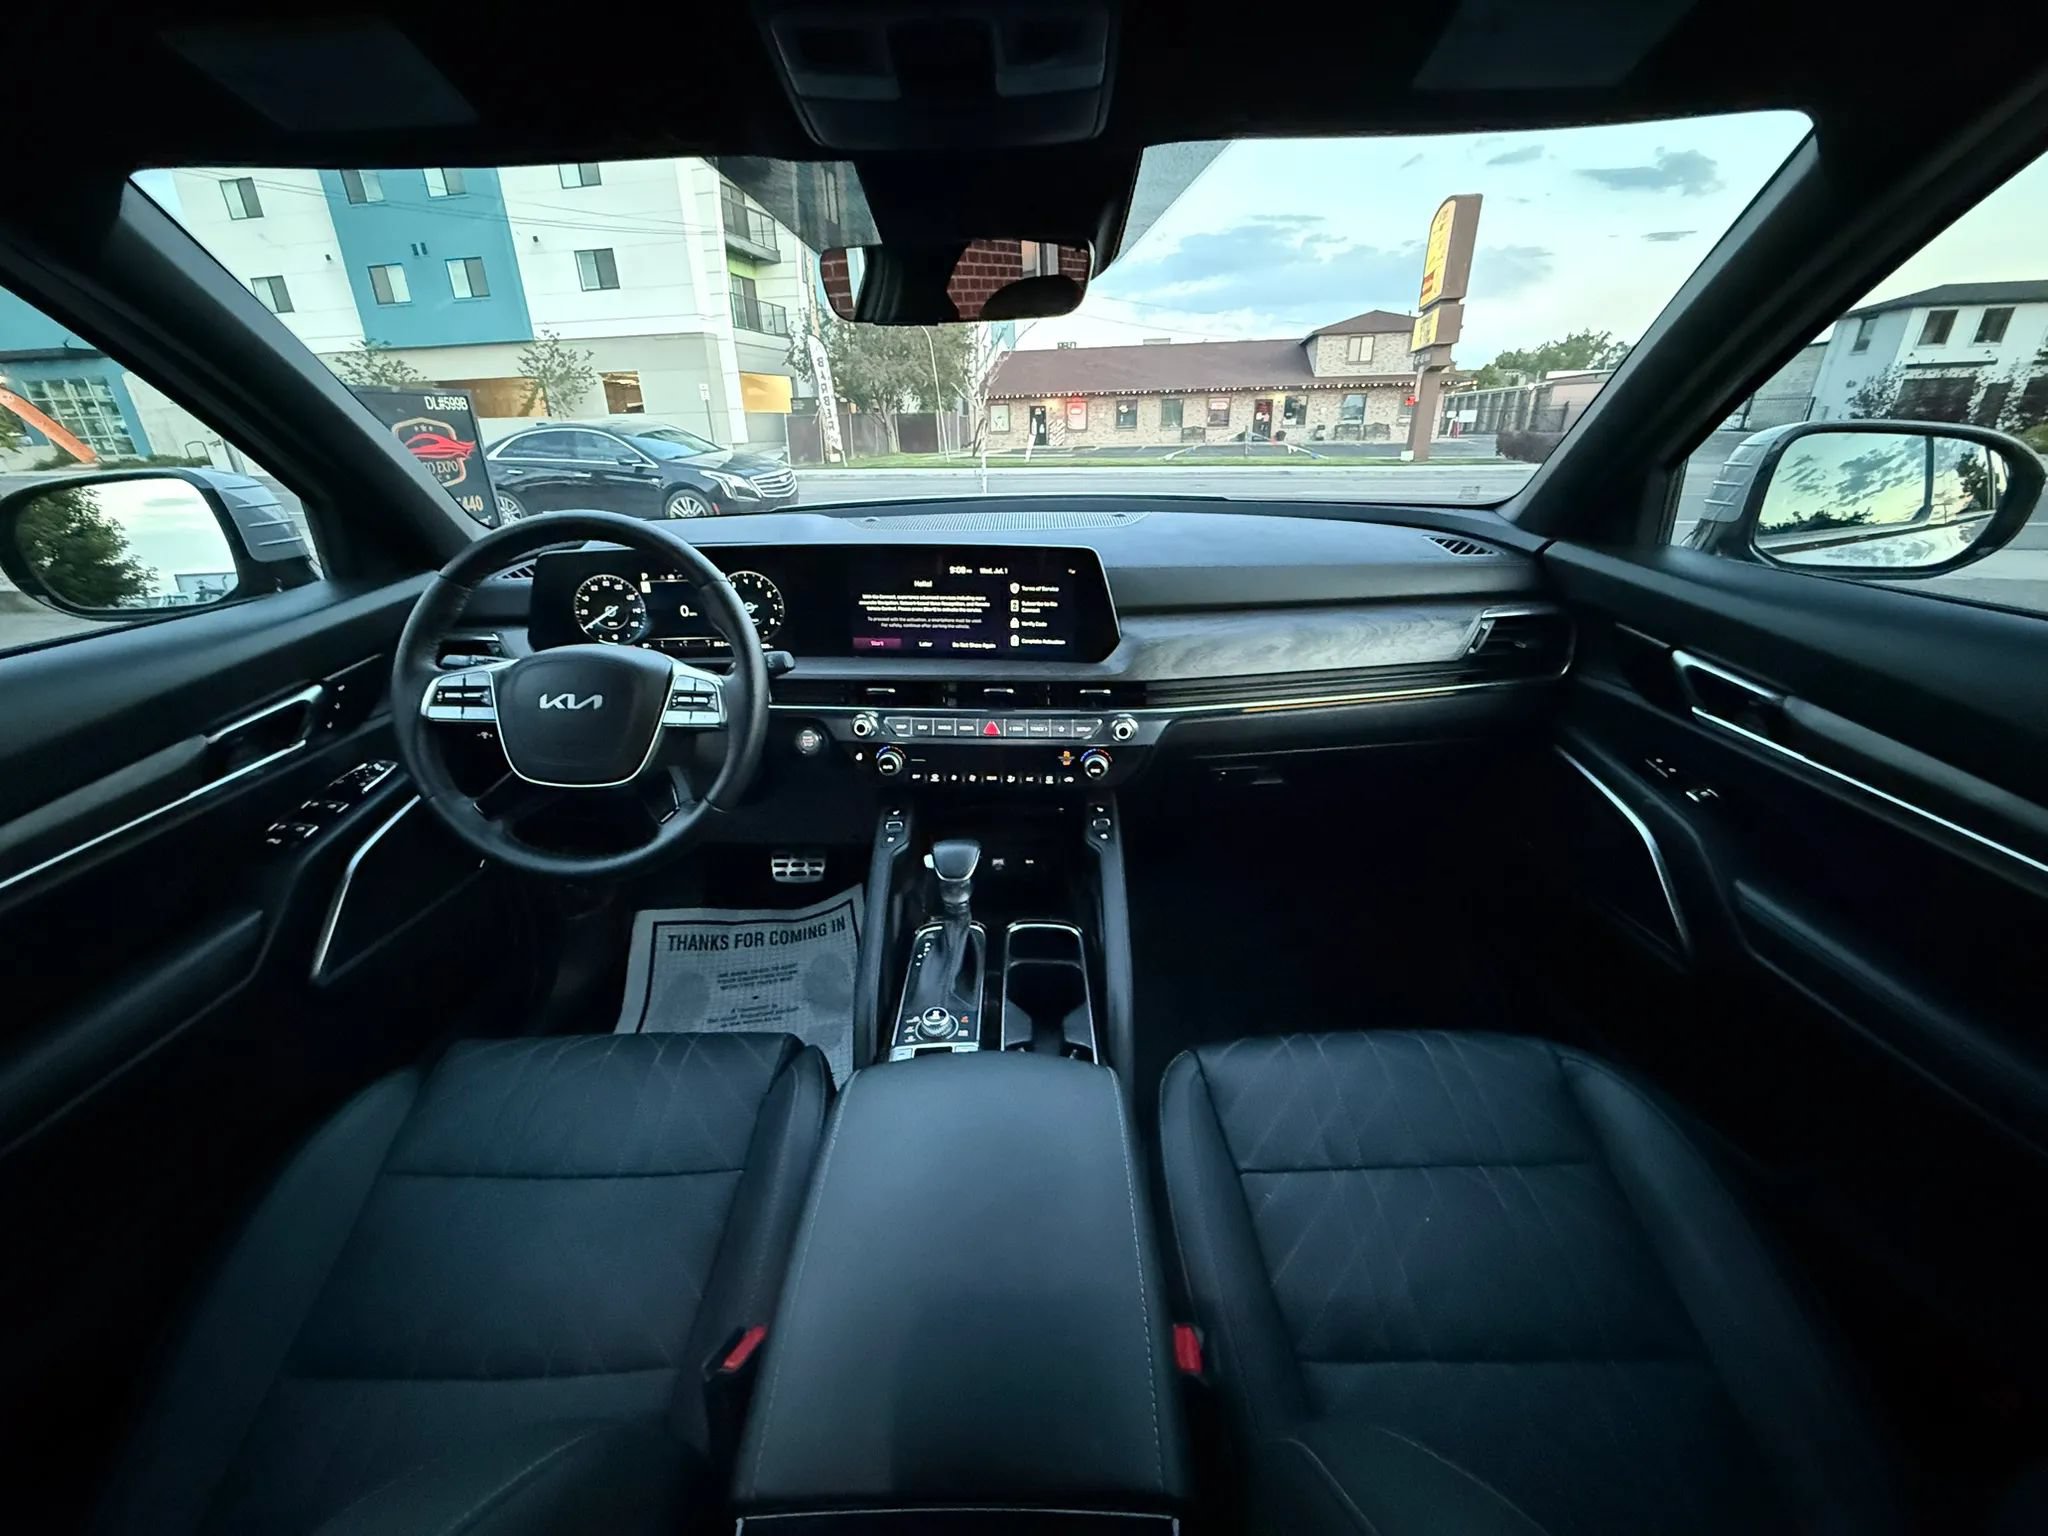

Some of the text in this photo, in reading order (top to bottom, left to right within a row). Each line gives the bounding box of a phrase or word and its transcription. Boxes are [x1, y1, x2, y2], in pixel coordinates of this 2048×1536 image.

[456, 495, 484, 512] 440
[641, 572, 648, 580] P
[680, 605, 689, 617] 0
[668, 916, 846, 952] THANKS FOR COMING IN
